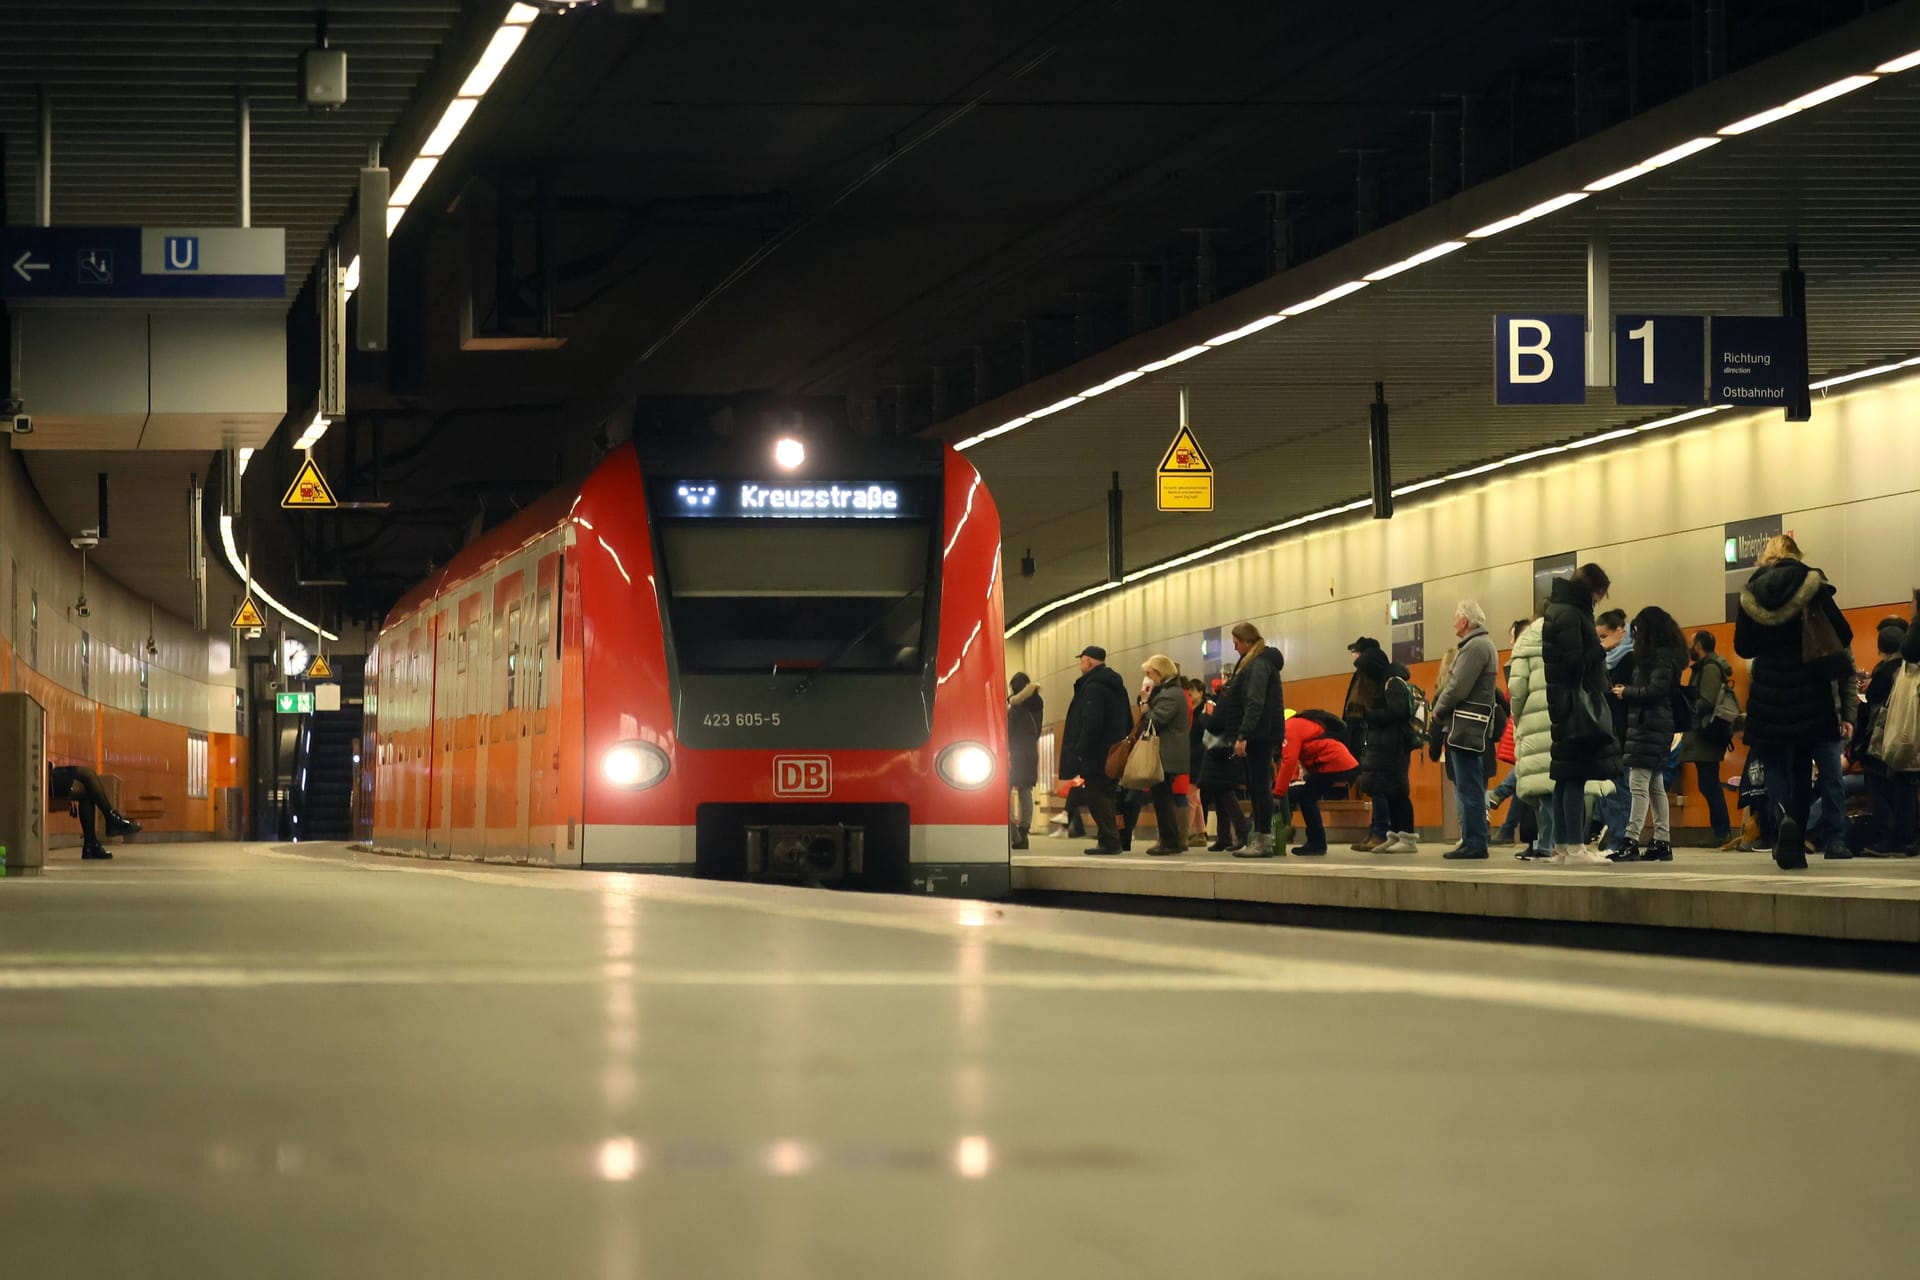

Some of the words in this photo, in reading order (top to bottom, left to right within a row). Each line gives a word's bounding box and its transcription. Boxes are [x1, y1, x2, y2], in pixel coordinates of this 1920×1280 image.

[170, 239, 193, 268] U
[1508, 319, 1554, 385] B
[1628, 319, 1655, 385] 1
[1723, 352, 1771, 366] Richtung
[1722, 386, 1785, 398] Ostbahnhof
[741, 484, 898, 510] Kreuzstraße
[1738, 532, 1770, 560] Marienpla
[703, 713, 730, 727] 423
[736, 713, 781, 727] 605-5
[779, 761, 825, 791] DB
